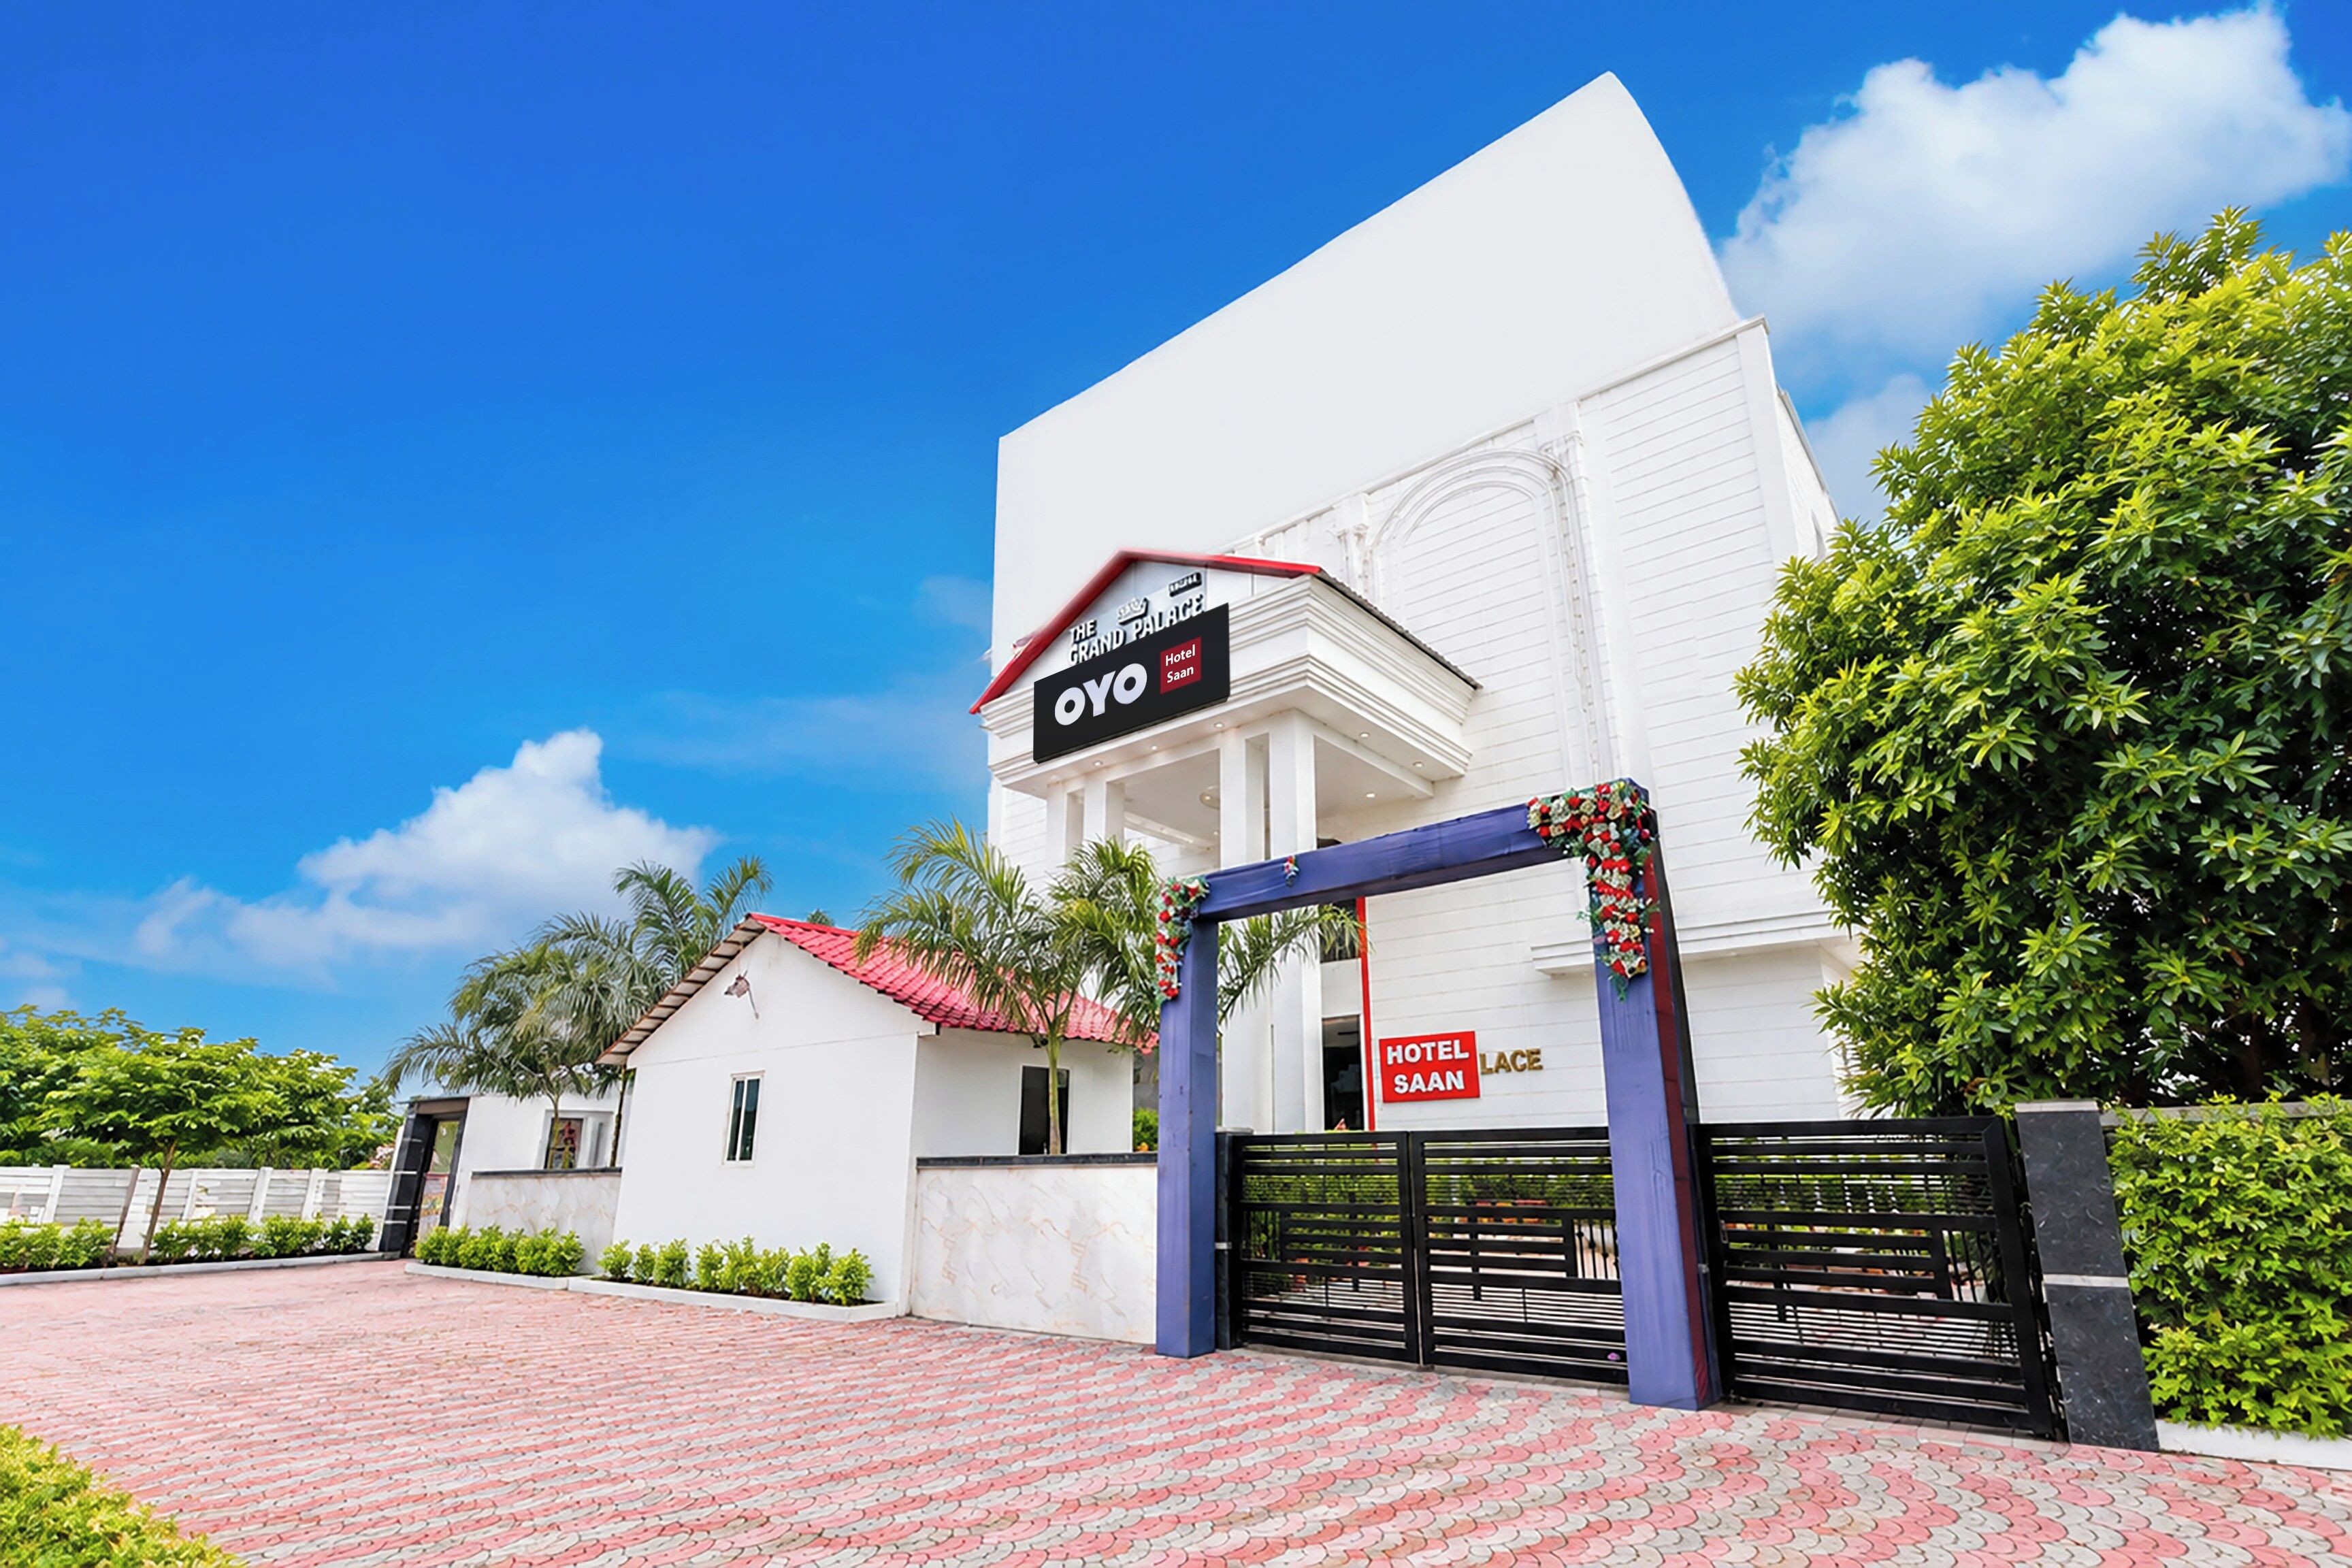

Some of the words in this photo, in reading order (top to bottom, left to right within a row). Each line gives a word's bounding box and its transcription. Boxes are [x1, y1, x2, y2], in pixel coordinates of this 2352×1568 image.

[1068, 627, 1126, 666] GRAND
[1132, 593, 1205, 640] PALACE
[1068, 619, 1097, 644] THE
[1165, 644, 1196, 666] Hotel
[1166, 666, 1194, 683] Saan
[1054, 663, 1147, 726] OYO
[1386, 1039, 1469, 1065] HOTEL
[1394, 1070, 1465, 1094] SAAN
